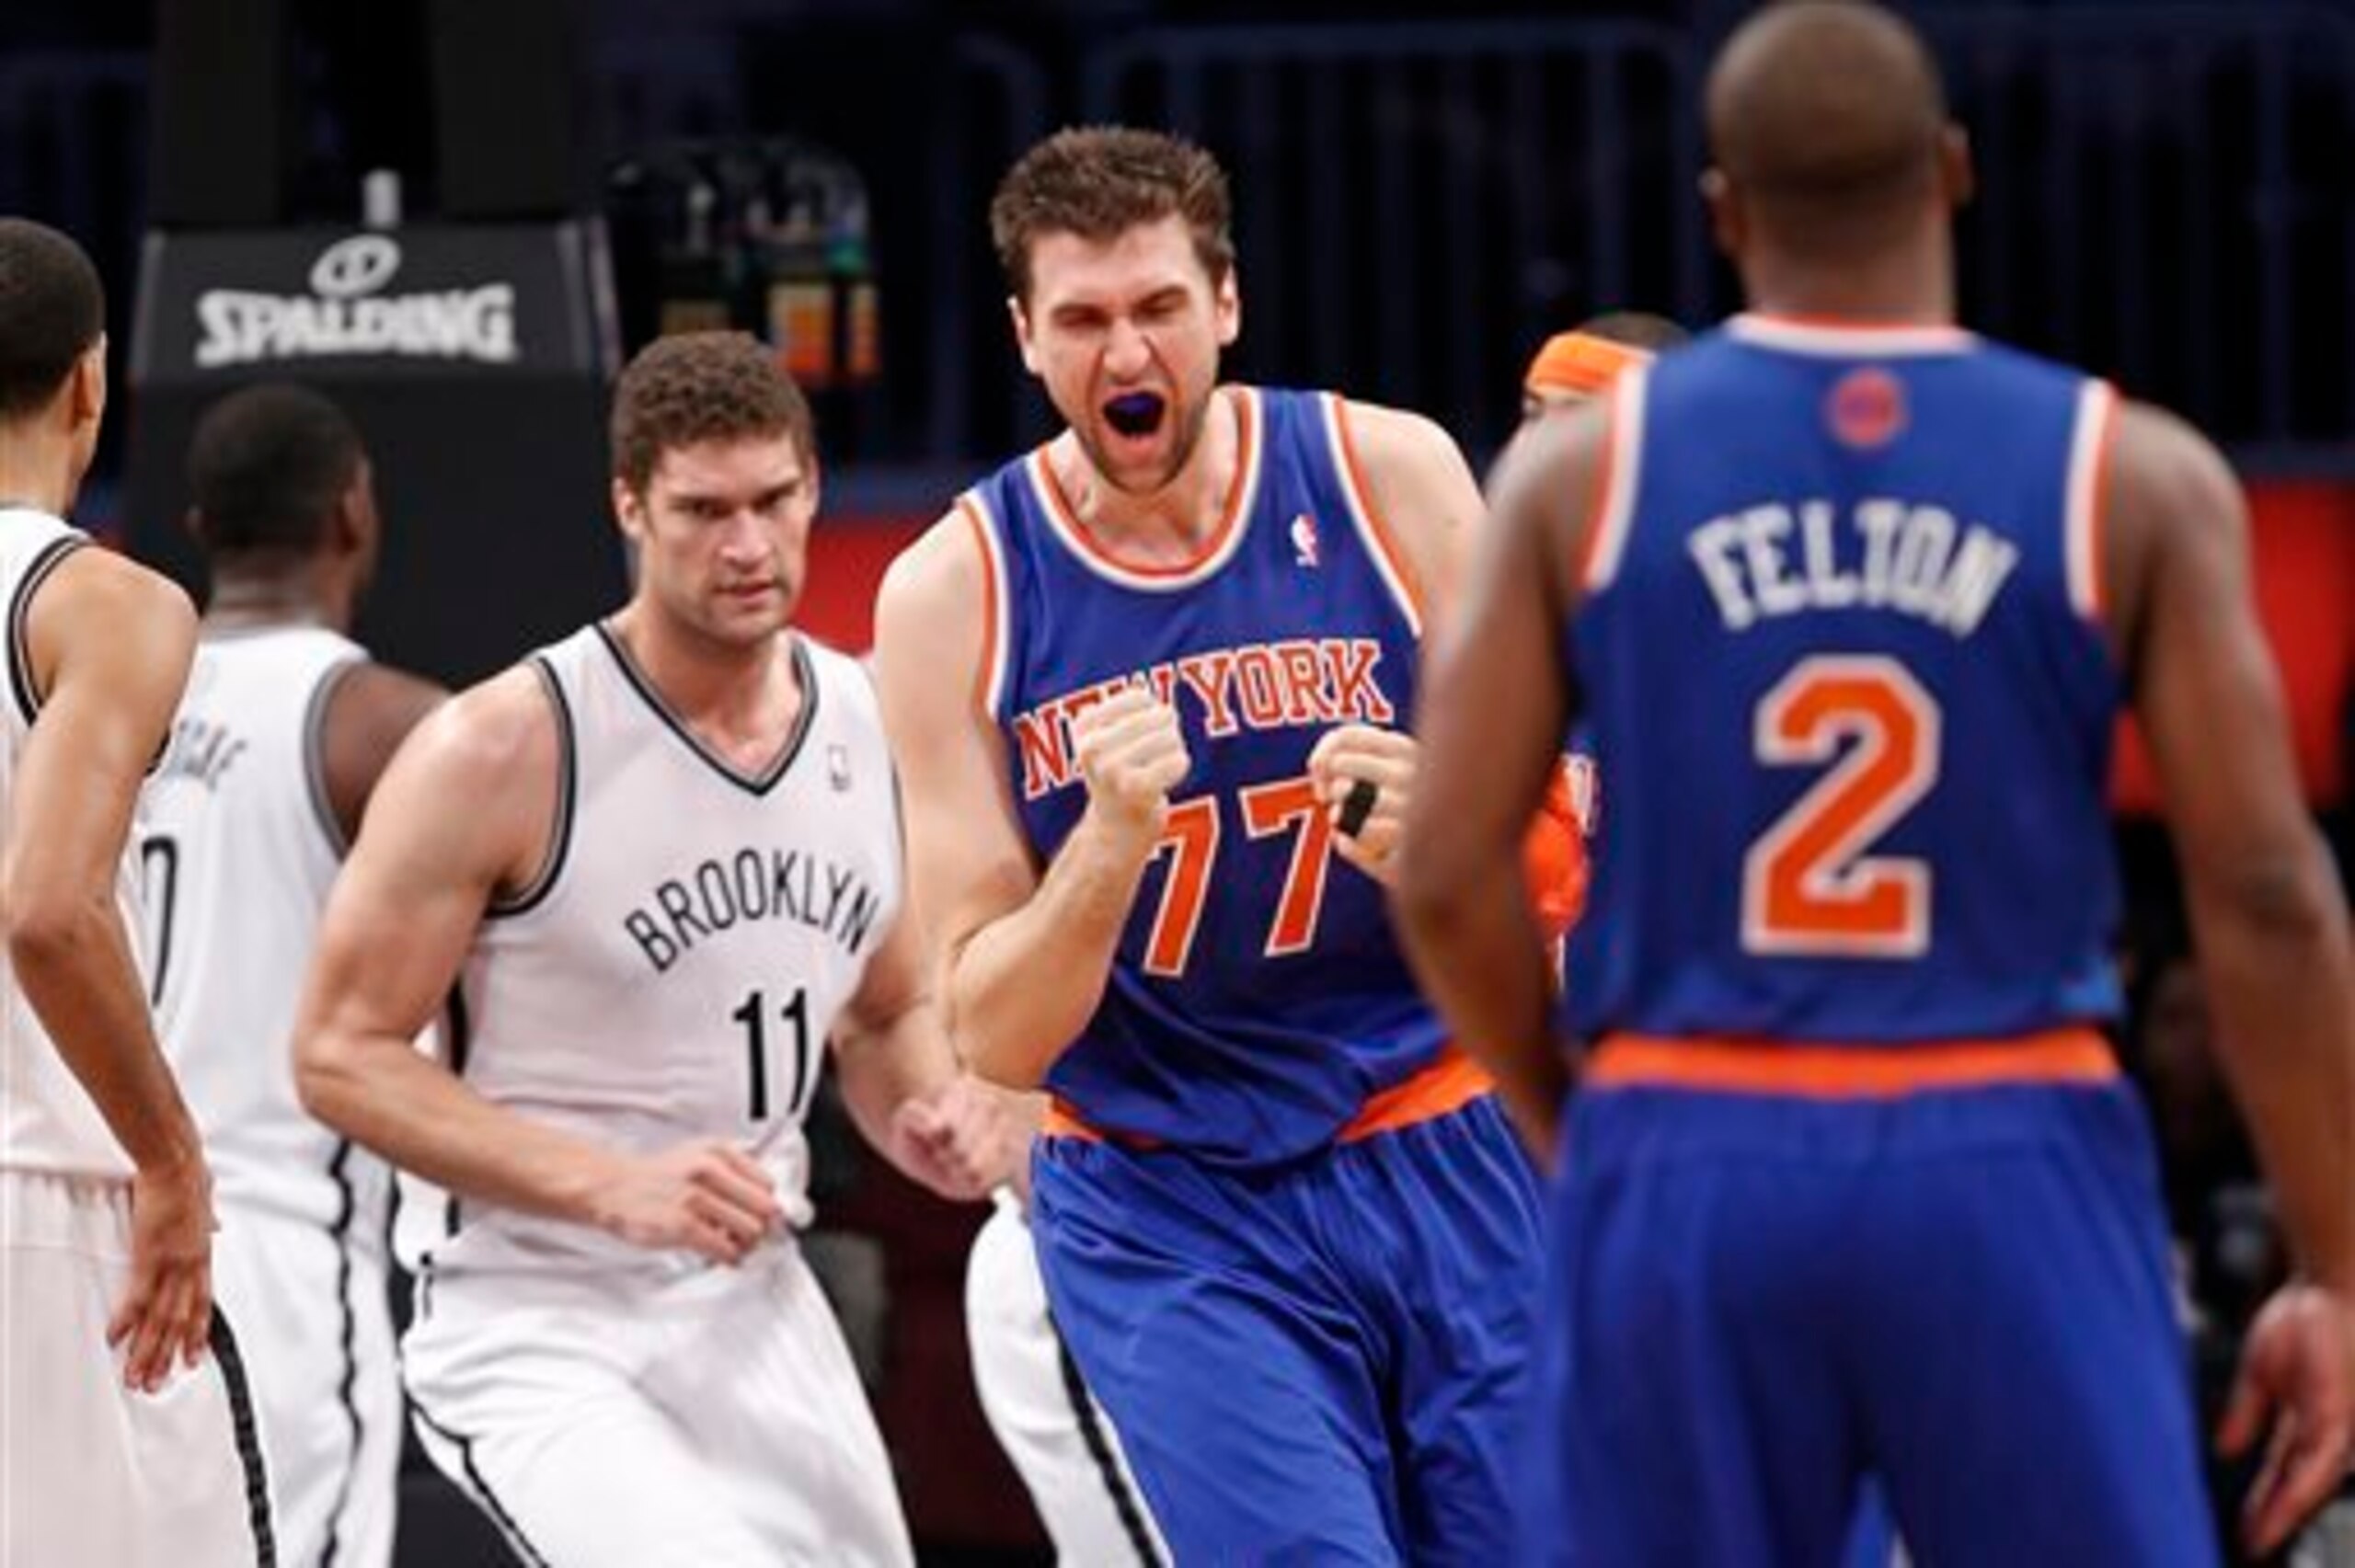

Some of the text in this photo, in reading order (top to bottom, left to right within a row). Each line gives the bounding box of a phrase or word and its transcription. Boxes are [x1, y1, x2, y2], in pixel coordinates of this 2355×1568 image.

[196, 283, 515, 368] SPALDING
[1688, 500, 2019, 635] FELTON
[1178, 639, 1395, 737] YORK
[1740, 654, 1942, 957] 2
[625, 847, 879, 973] BROOKLYN
[1143, 778, 1333, 977] 77
[732, 987, 808, 1121] 11
